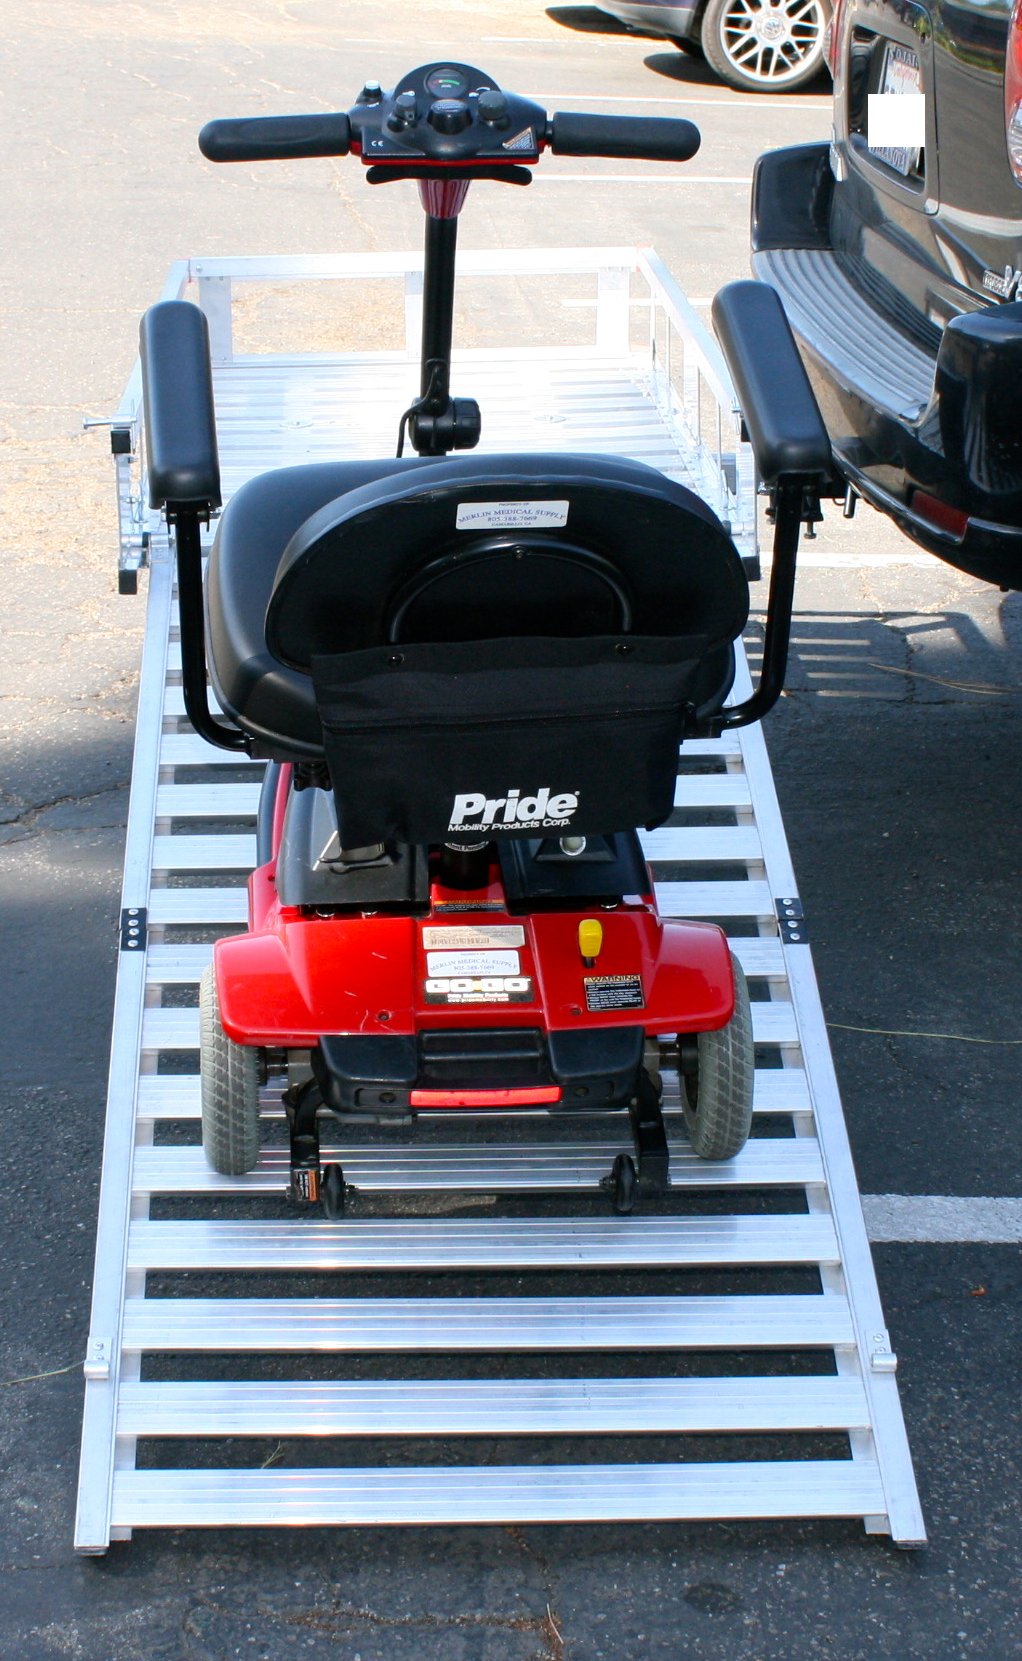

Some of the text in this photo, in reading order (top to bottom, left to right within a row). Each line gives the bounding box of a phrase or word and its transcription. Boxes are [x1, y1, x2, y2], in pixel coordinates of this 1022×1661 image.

[458, 511, 491, 523] MERLIN
[535, 510, 566, 520] SUPPLY
[450, 787, 579, 825] Pride
[447, 817, 571, 832] Mobility Products Corp.
[430, 960, 457, 972] MERLIN
